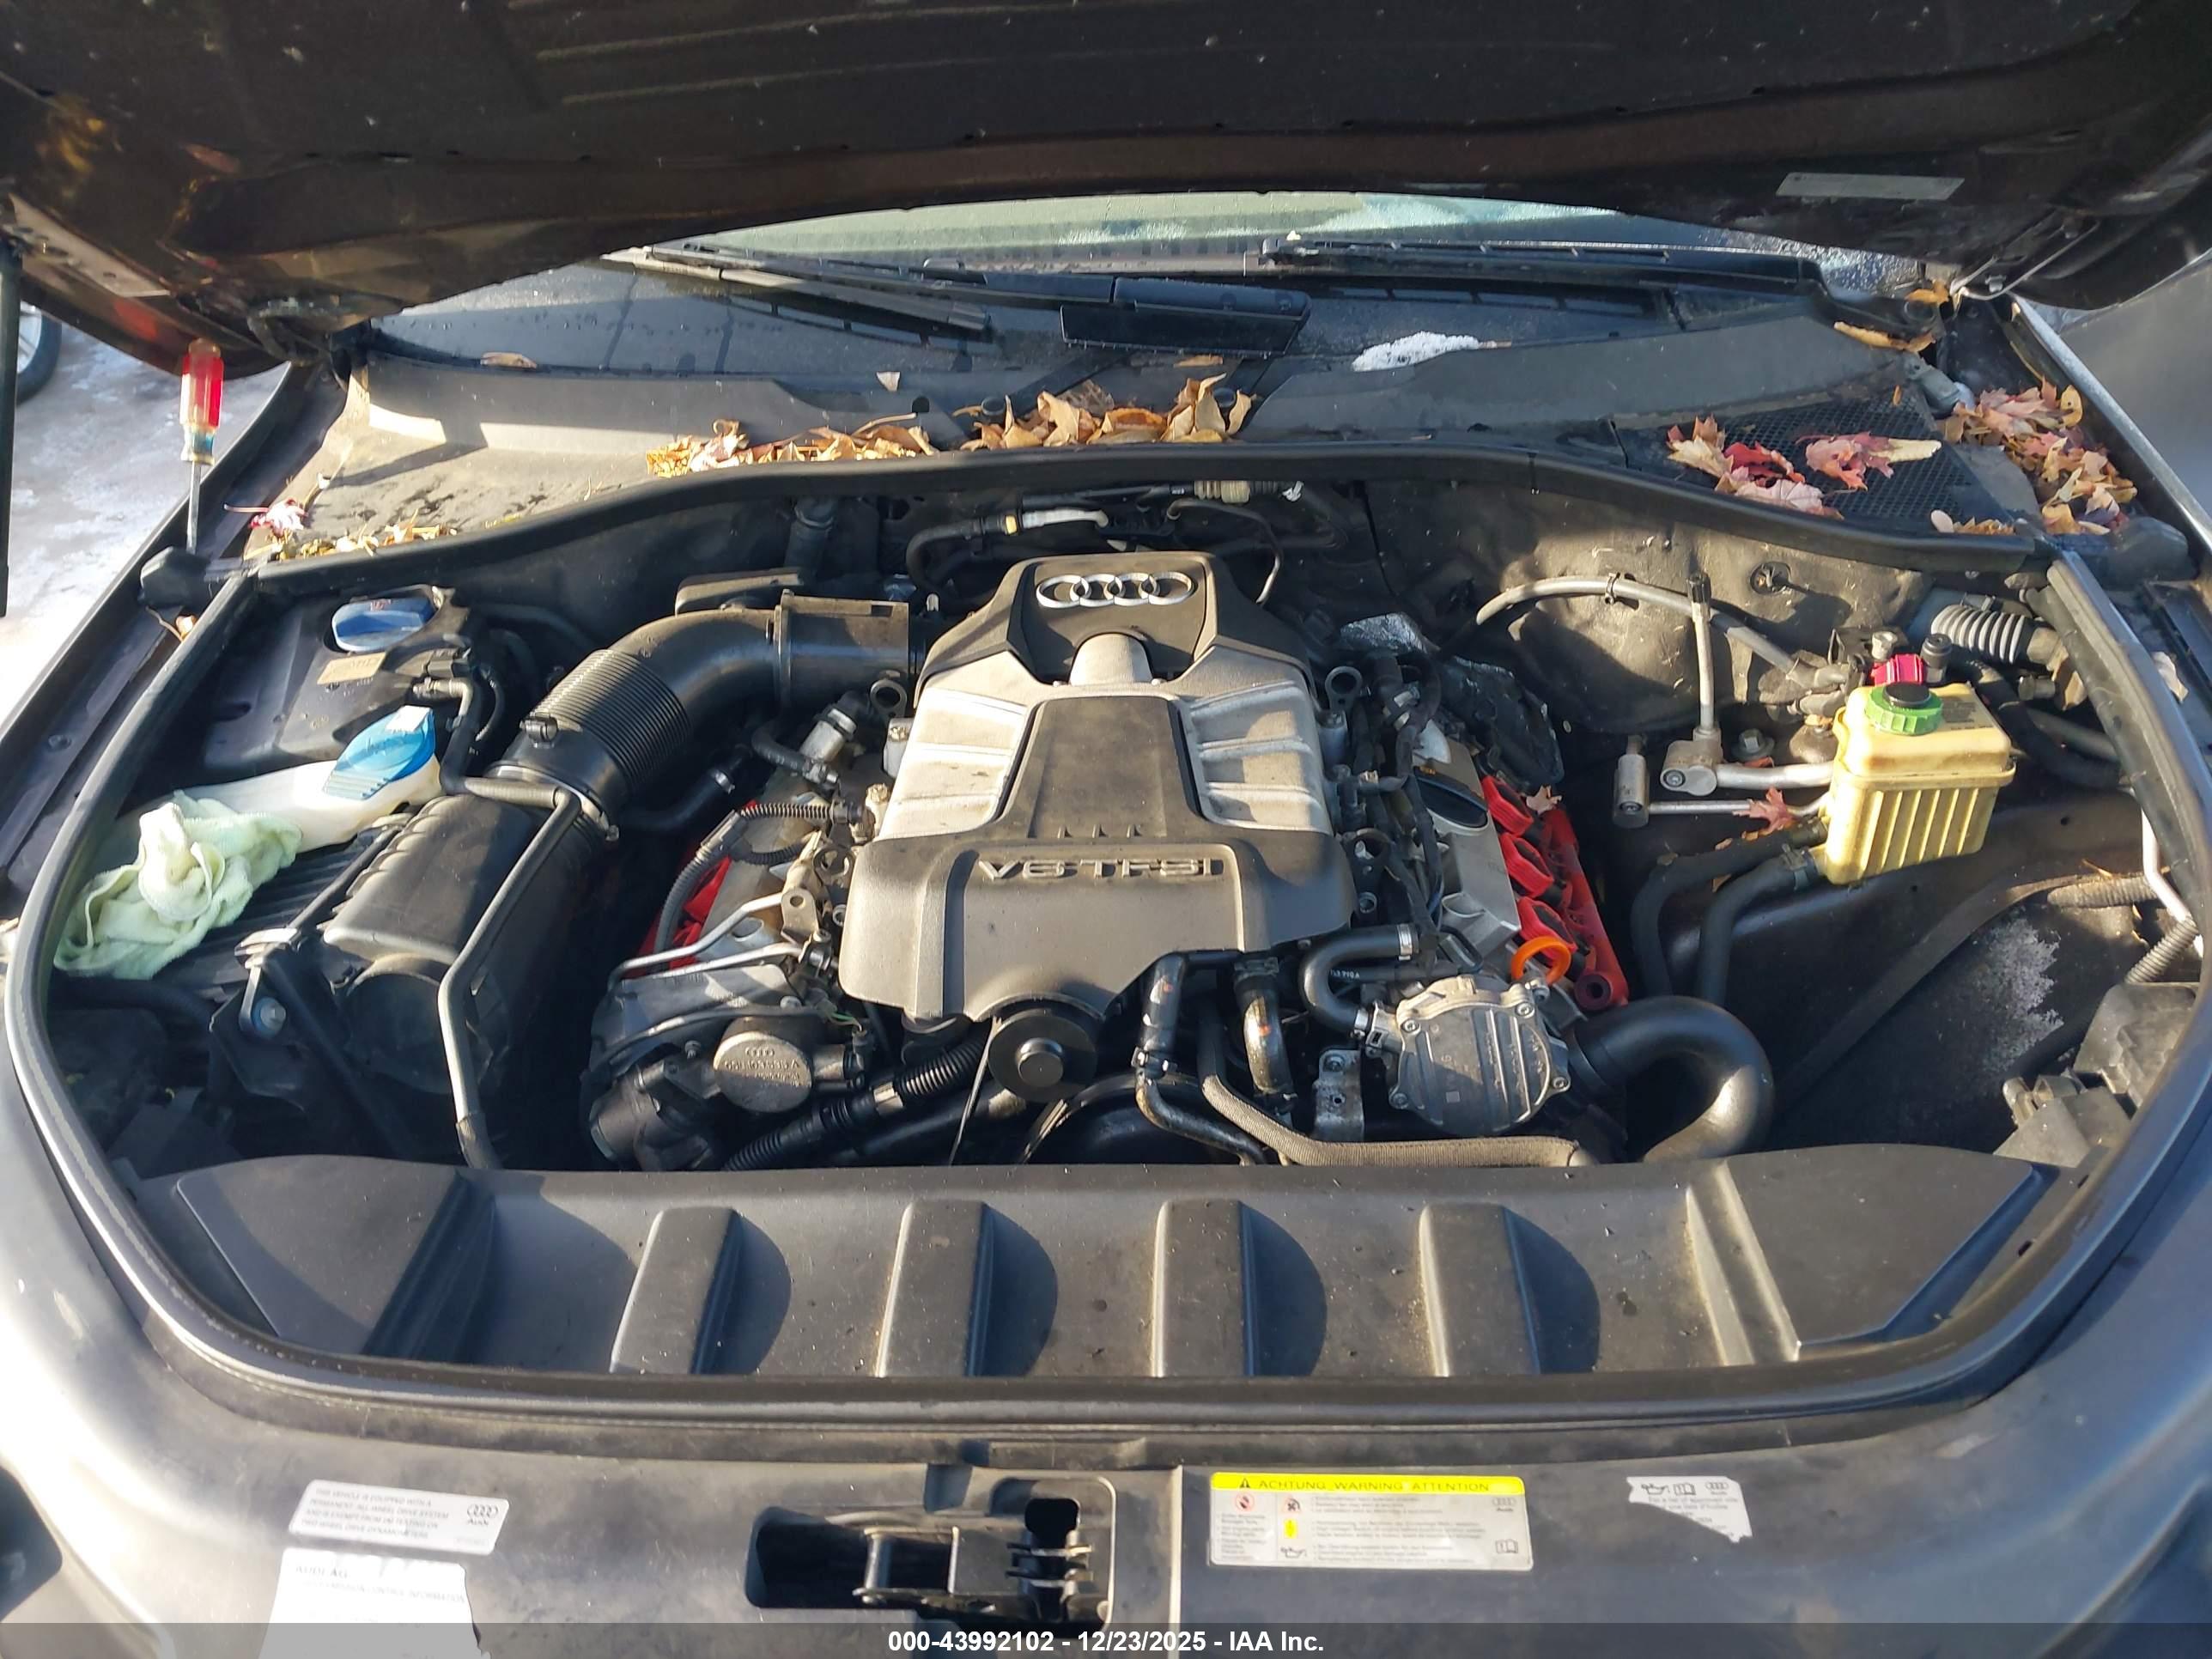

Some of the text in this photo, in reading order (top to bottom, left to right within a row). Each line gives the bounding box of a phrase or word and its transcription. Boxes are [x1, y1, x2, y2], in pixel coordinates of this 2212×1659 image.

[978, 858, 1216, 881] V6 TFSI
[1259, 1480, 1490, 1492] ACHTUNG WARNING ATTENTION
